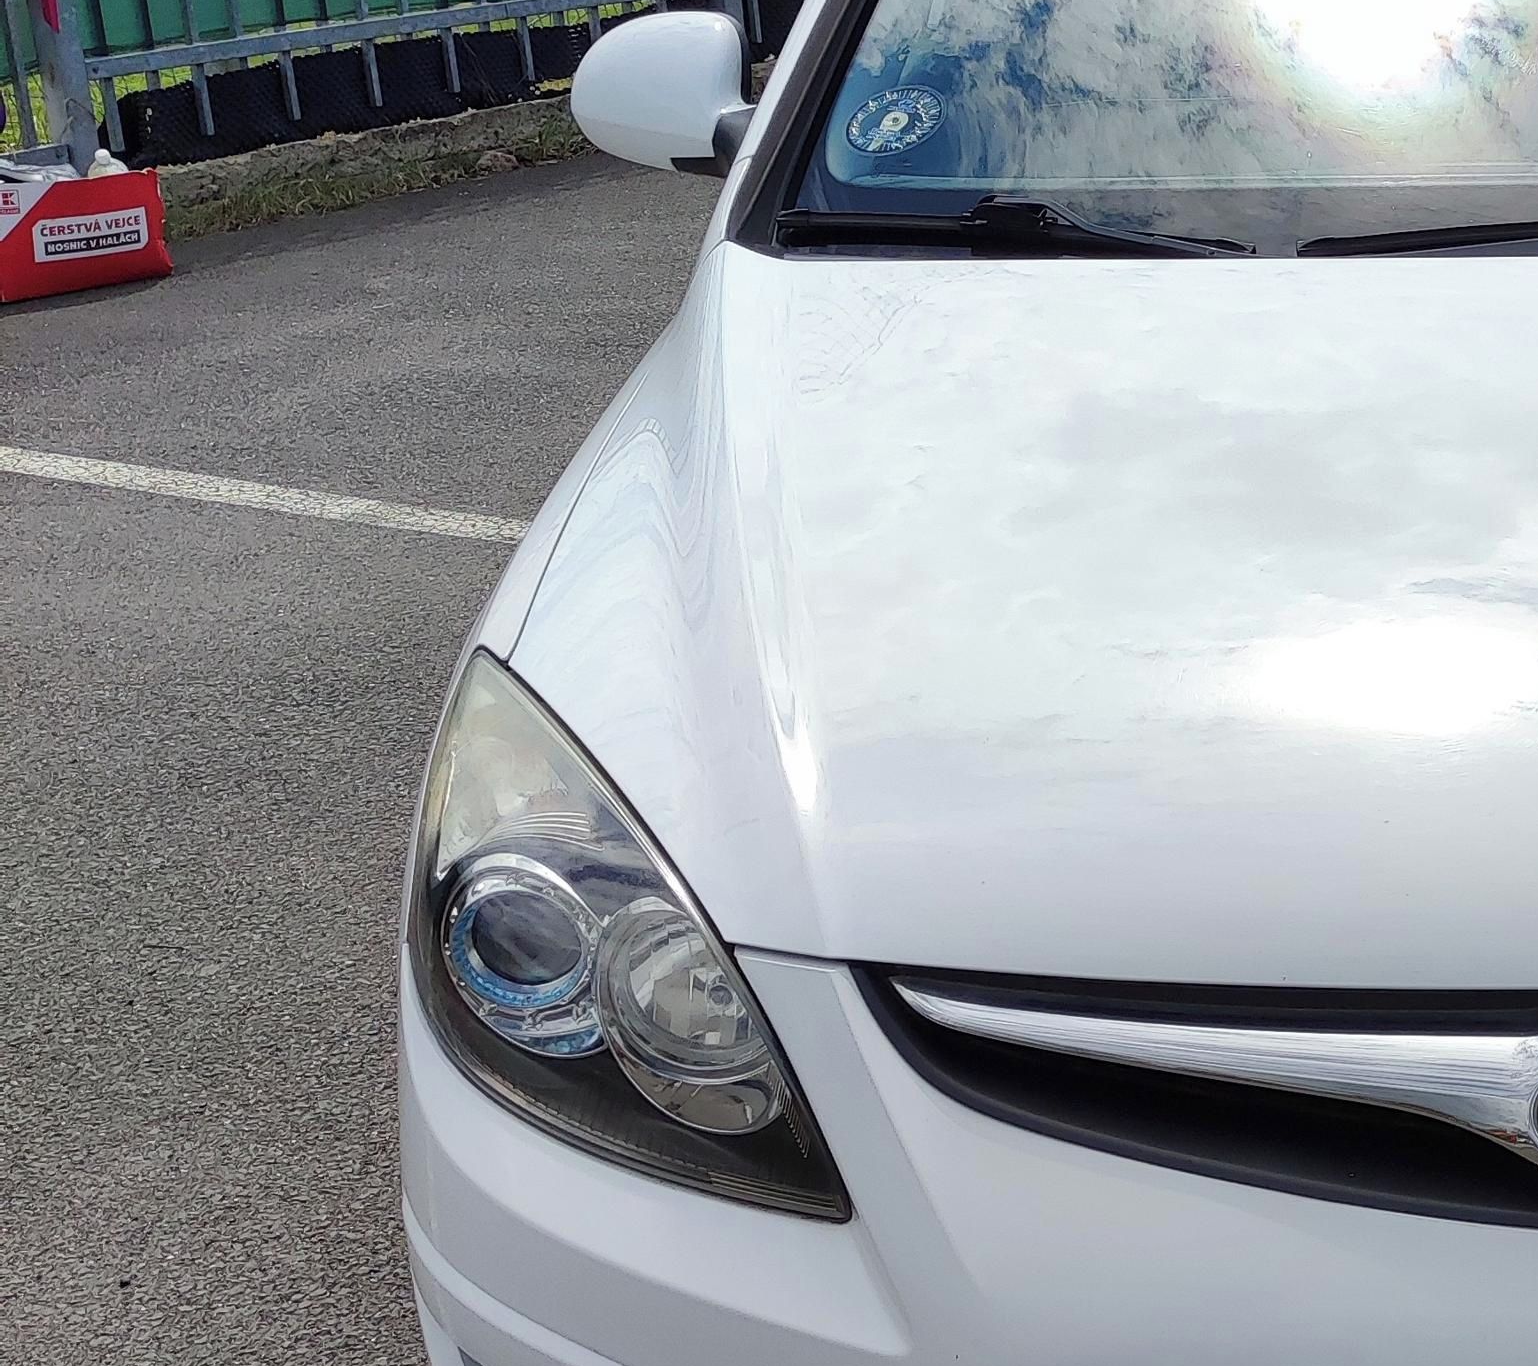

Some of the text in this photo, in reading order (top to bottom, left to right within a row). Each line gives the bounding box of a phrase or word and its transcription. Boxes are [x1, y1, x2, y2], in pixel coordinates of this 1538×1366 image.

[40, 215, 141, 237] ČERSTVÁ VEJCE
[47, 232, 138, 253] NOSNIC V HALÁCH
